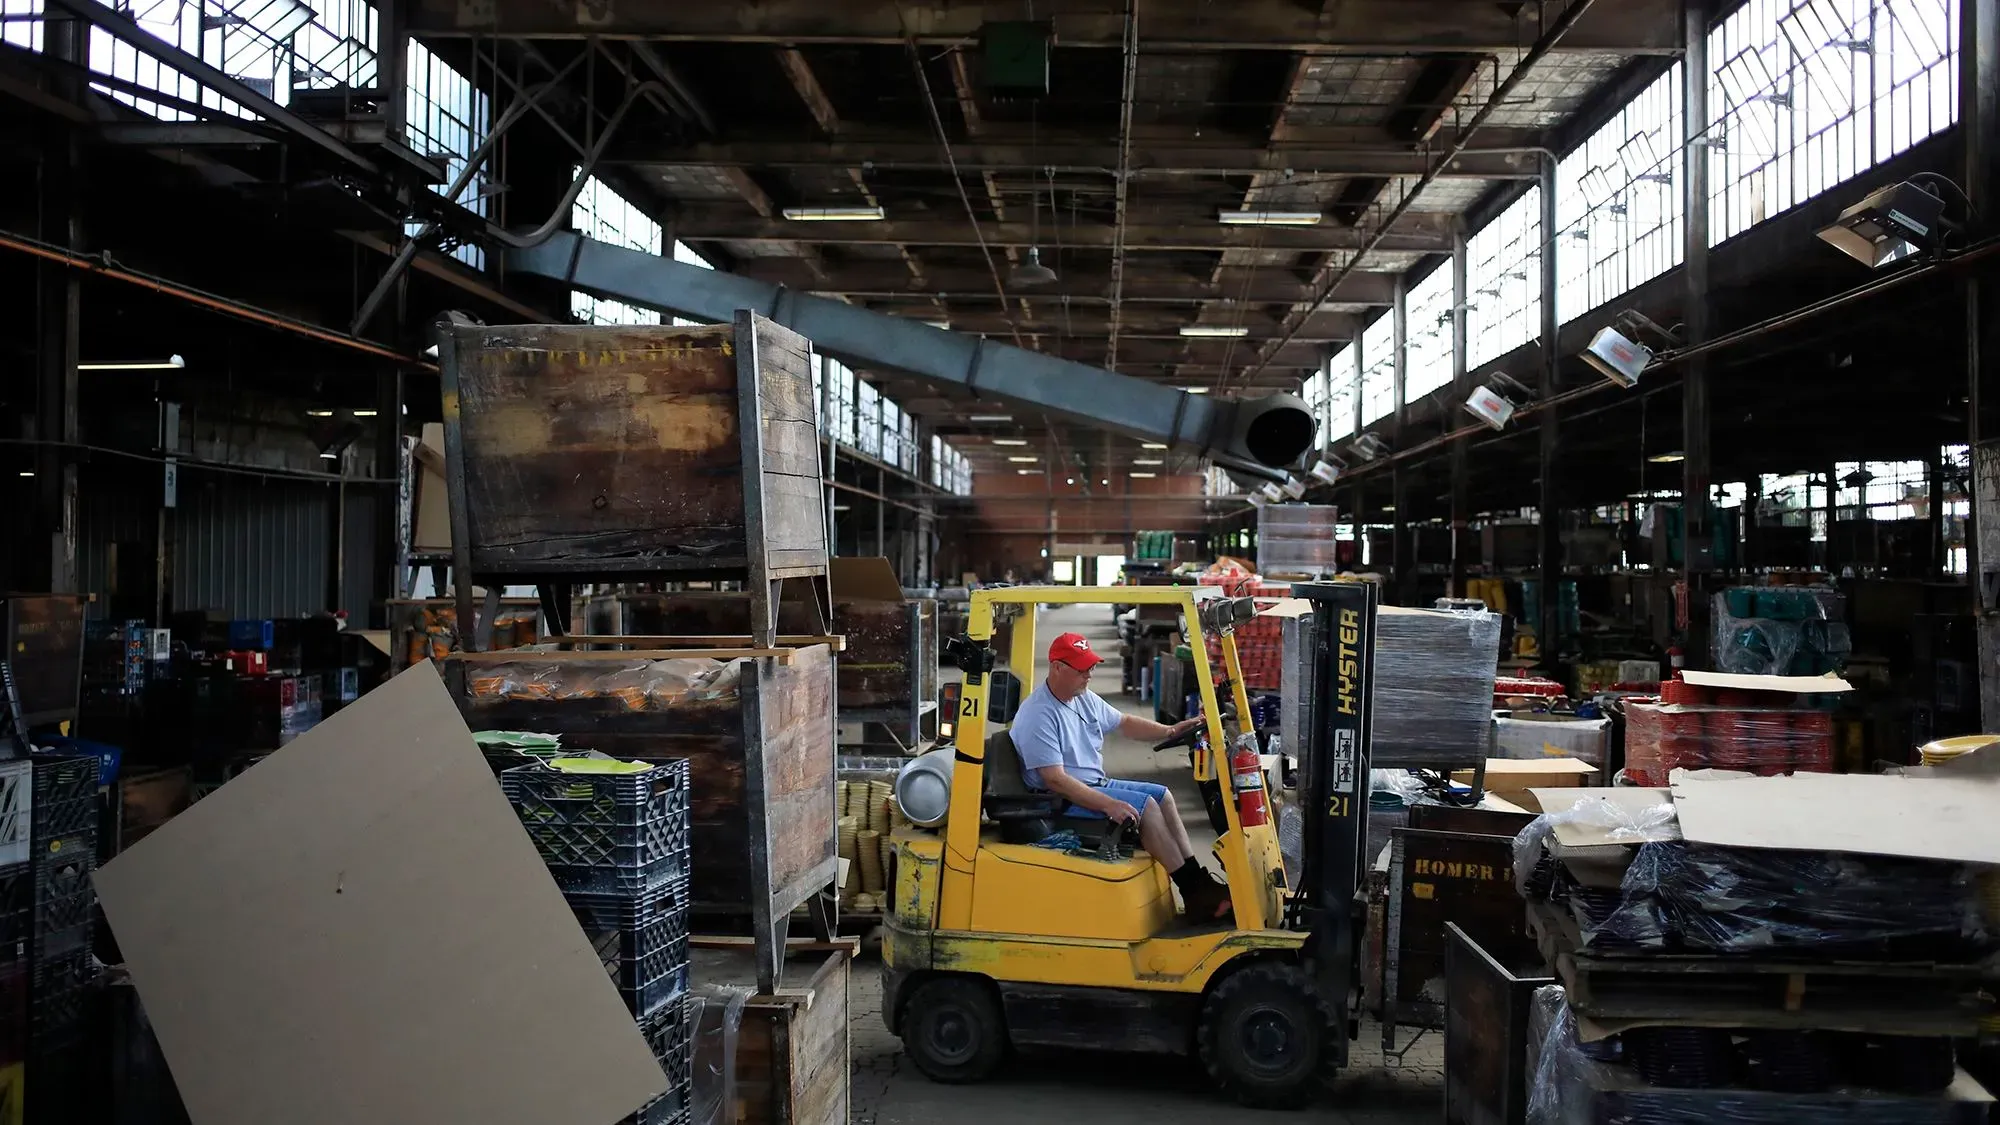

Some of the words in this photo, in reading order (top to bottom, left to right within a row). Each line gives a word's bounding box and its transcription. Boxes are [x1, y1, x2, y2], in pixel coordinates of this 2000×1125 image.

[1338, 608, 1358, 715] HYSTER
[963, 698, 978, 717] 21
[1329, 796, 1349, 817] 21
[1414, 858, 1495, 881] HOMER
